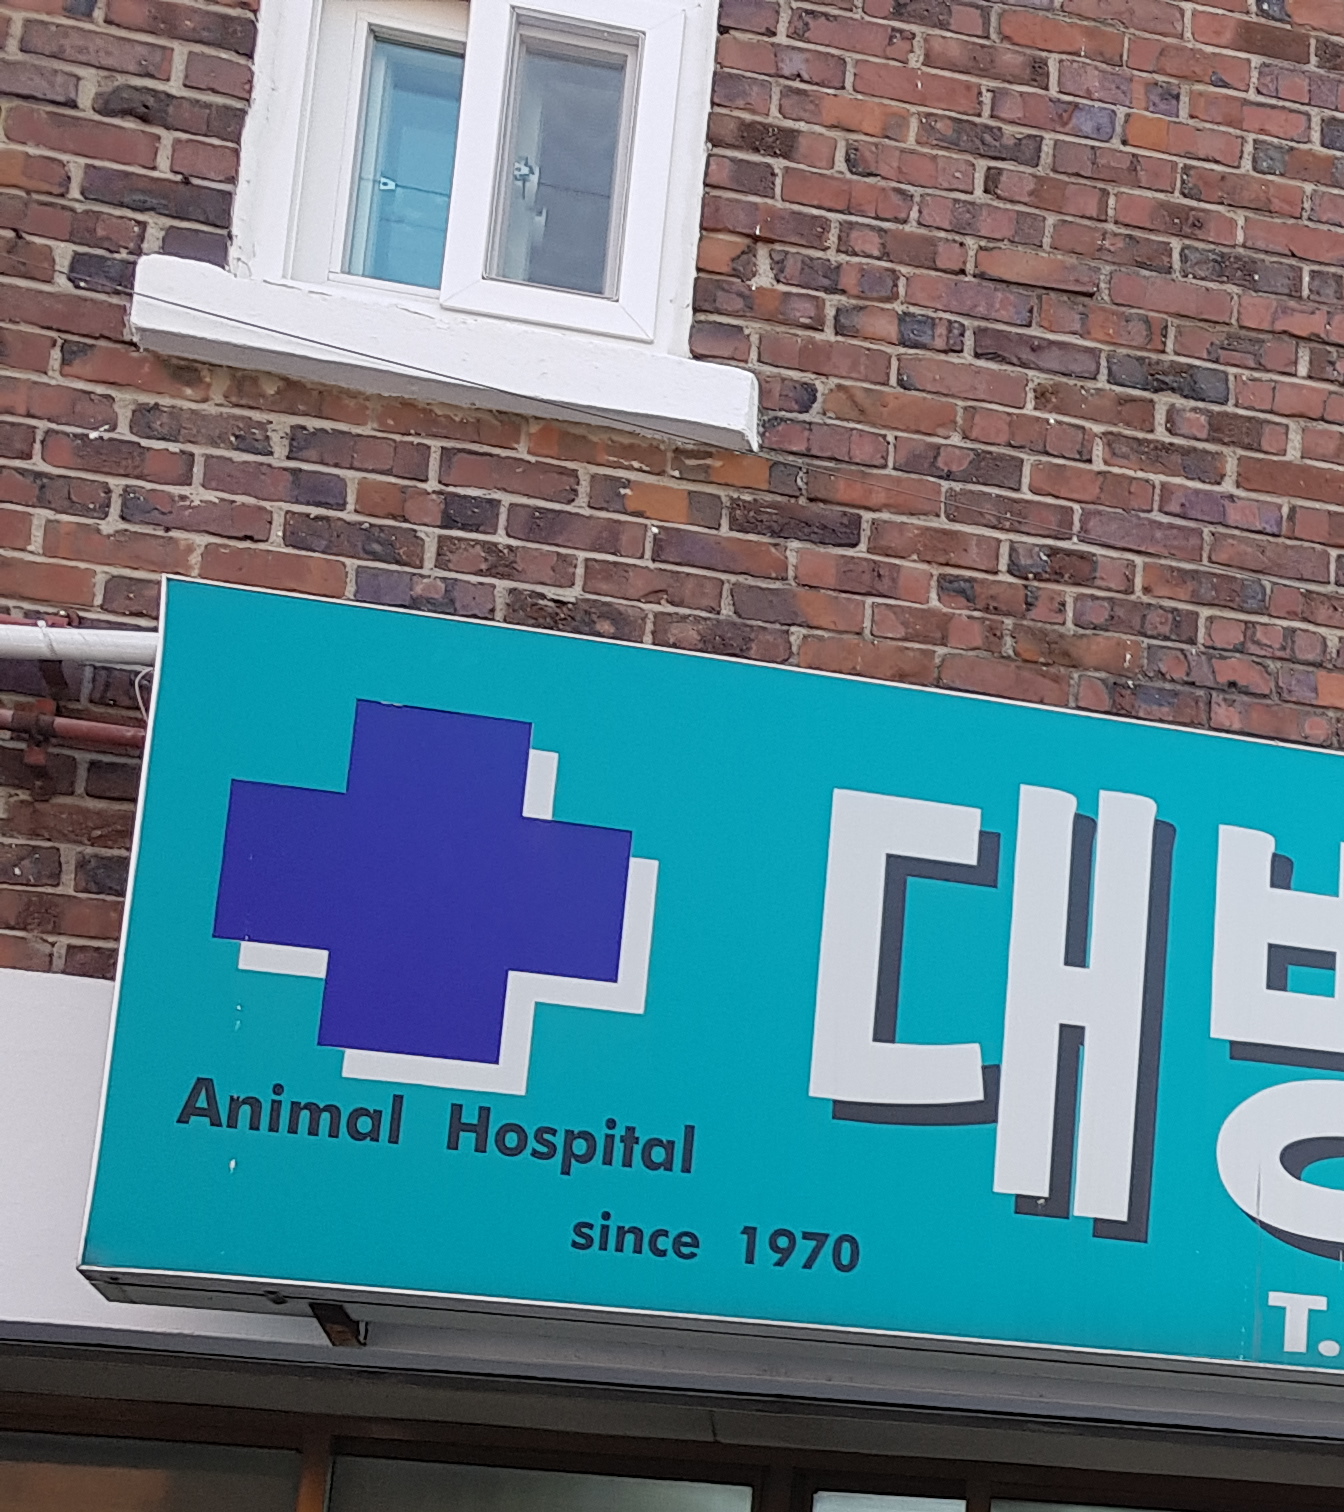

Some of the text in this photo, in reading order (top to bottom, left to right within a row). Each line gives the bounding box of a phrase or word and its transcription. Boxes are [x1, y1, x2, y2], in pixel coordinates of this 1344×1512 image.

[176, 1076, 696, 1177] Animal Hospital
[570, 1211, 861, 1274] since 1970
